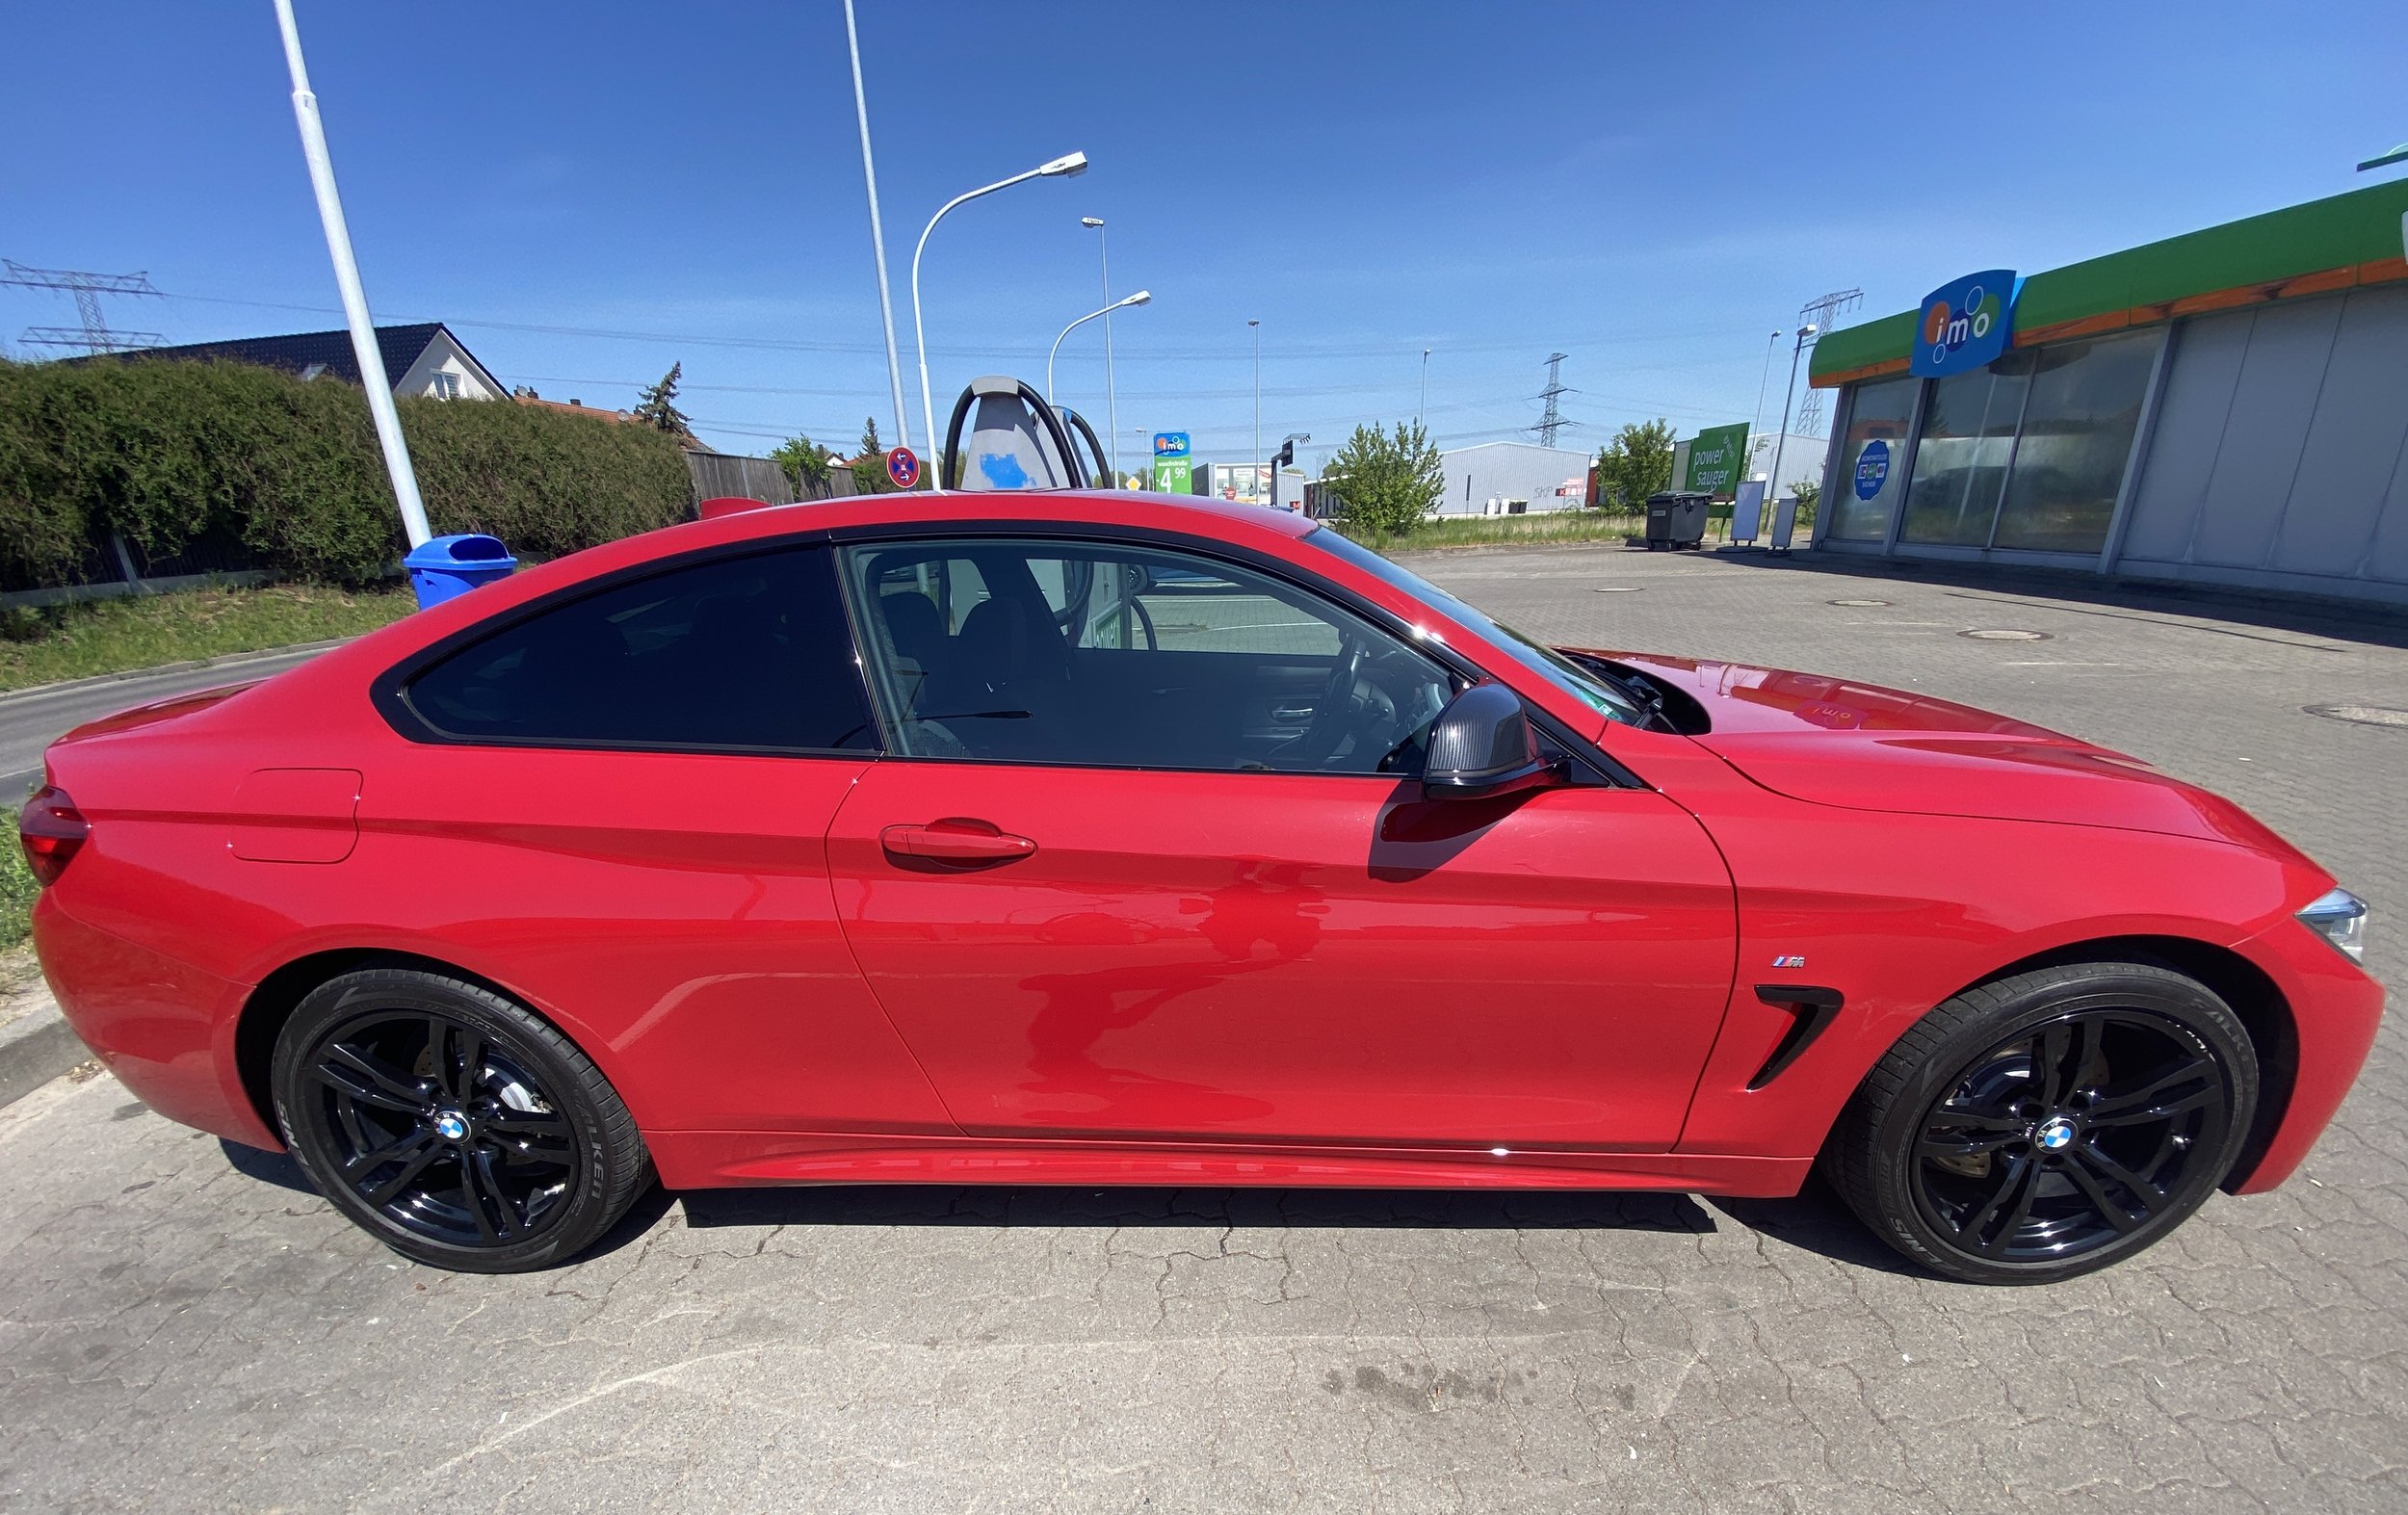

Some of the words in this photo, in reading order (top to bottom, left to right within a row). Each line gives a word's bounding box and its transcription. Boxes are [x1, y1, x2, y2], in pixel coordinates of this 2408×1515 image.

[1935, 311, 1990, 345] imo
[1163, 441, 1184, 451] imo
[1692, 449, 1725, 472] power
[1695, 469, 1730, 494] sauger
[574, 1101, 604, 1199] ALKEN
